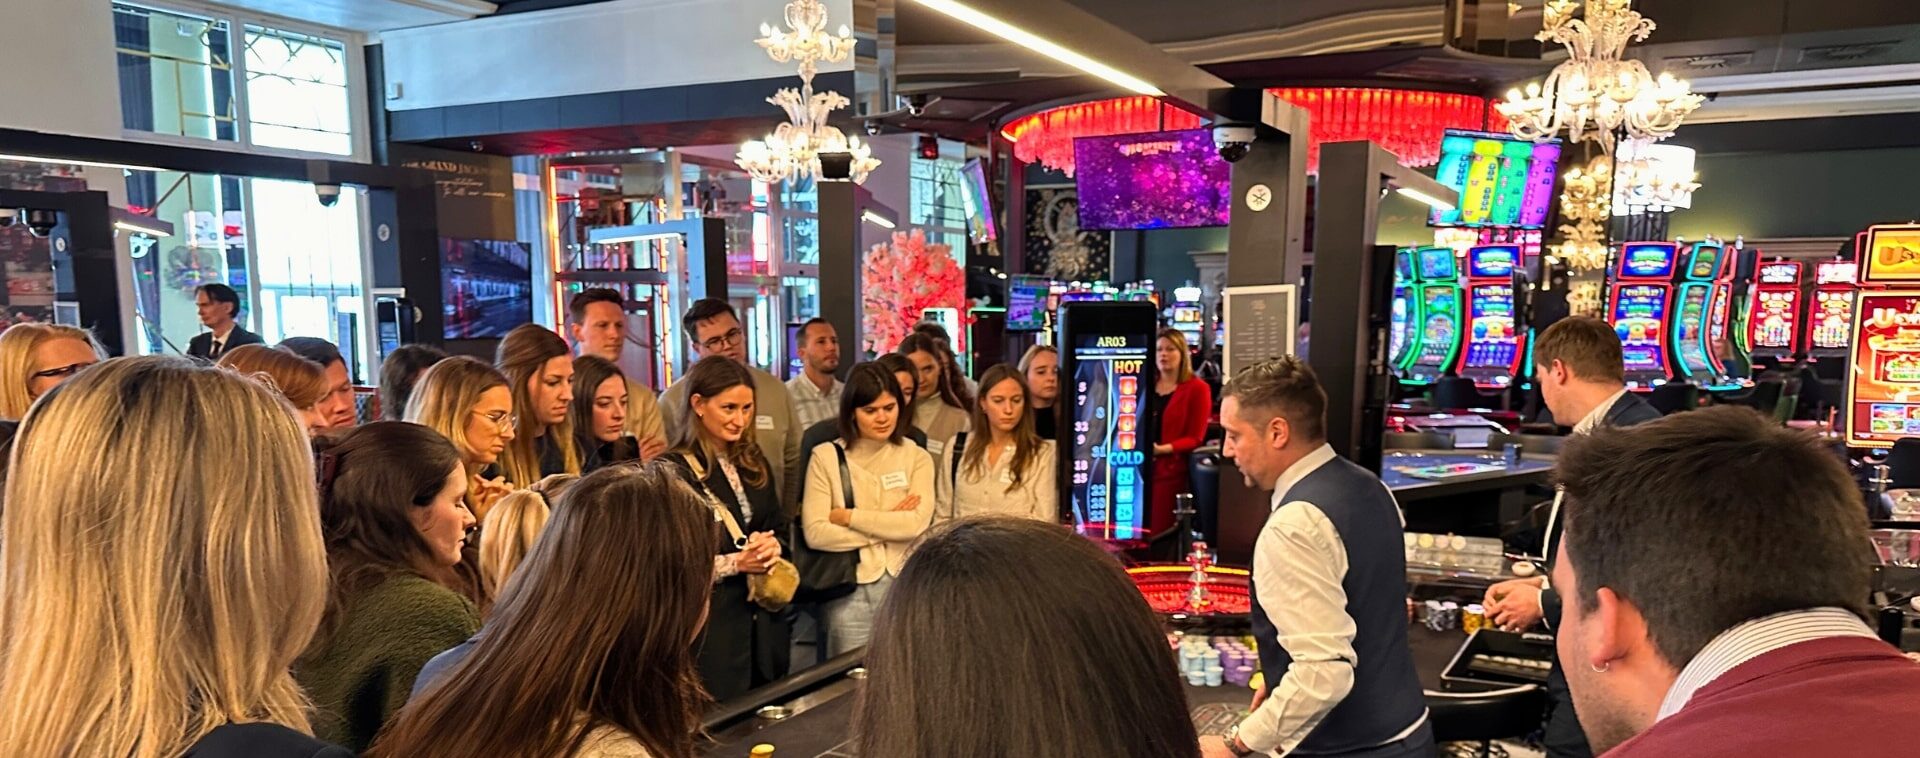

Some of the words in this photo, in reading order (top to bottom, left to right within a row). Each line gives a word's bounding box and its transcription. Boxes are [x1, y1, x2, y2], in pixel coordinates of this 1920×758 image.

[1096, 336, 1126, 347] AR03
[1114, 360, 1143, 374] HOT
[1078, 394, 1087, 406] 7
[1076, 434, 1086, 445] 9
[1109, 450, 1144, 465] COLD
